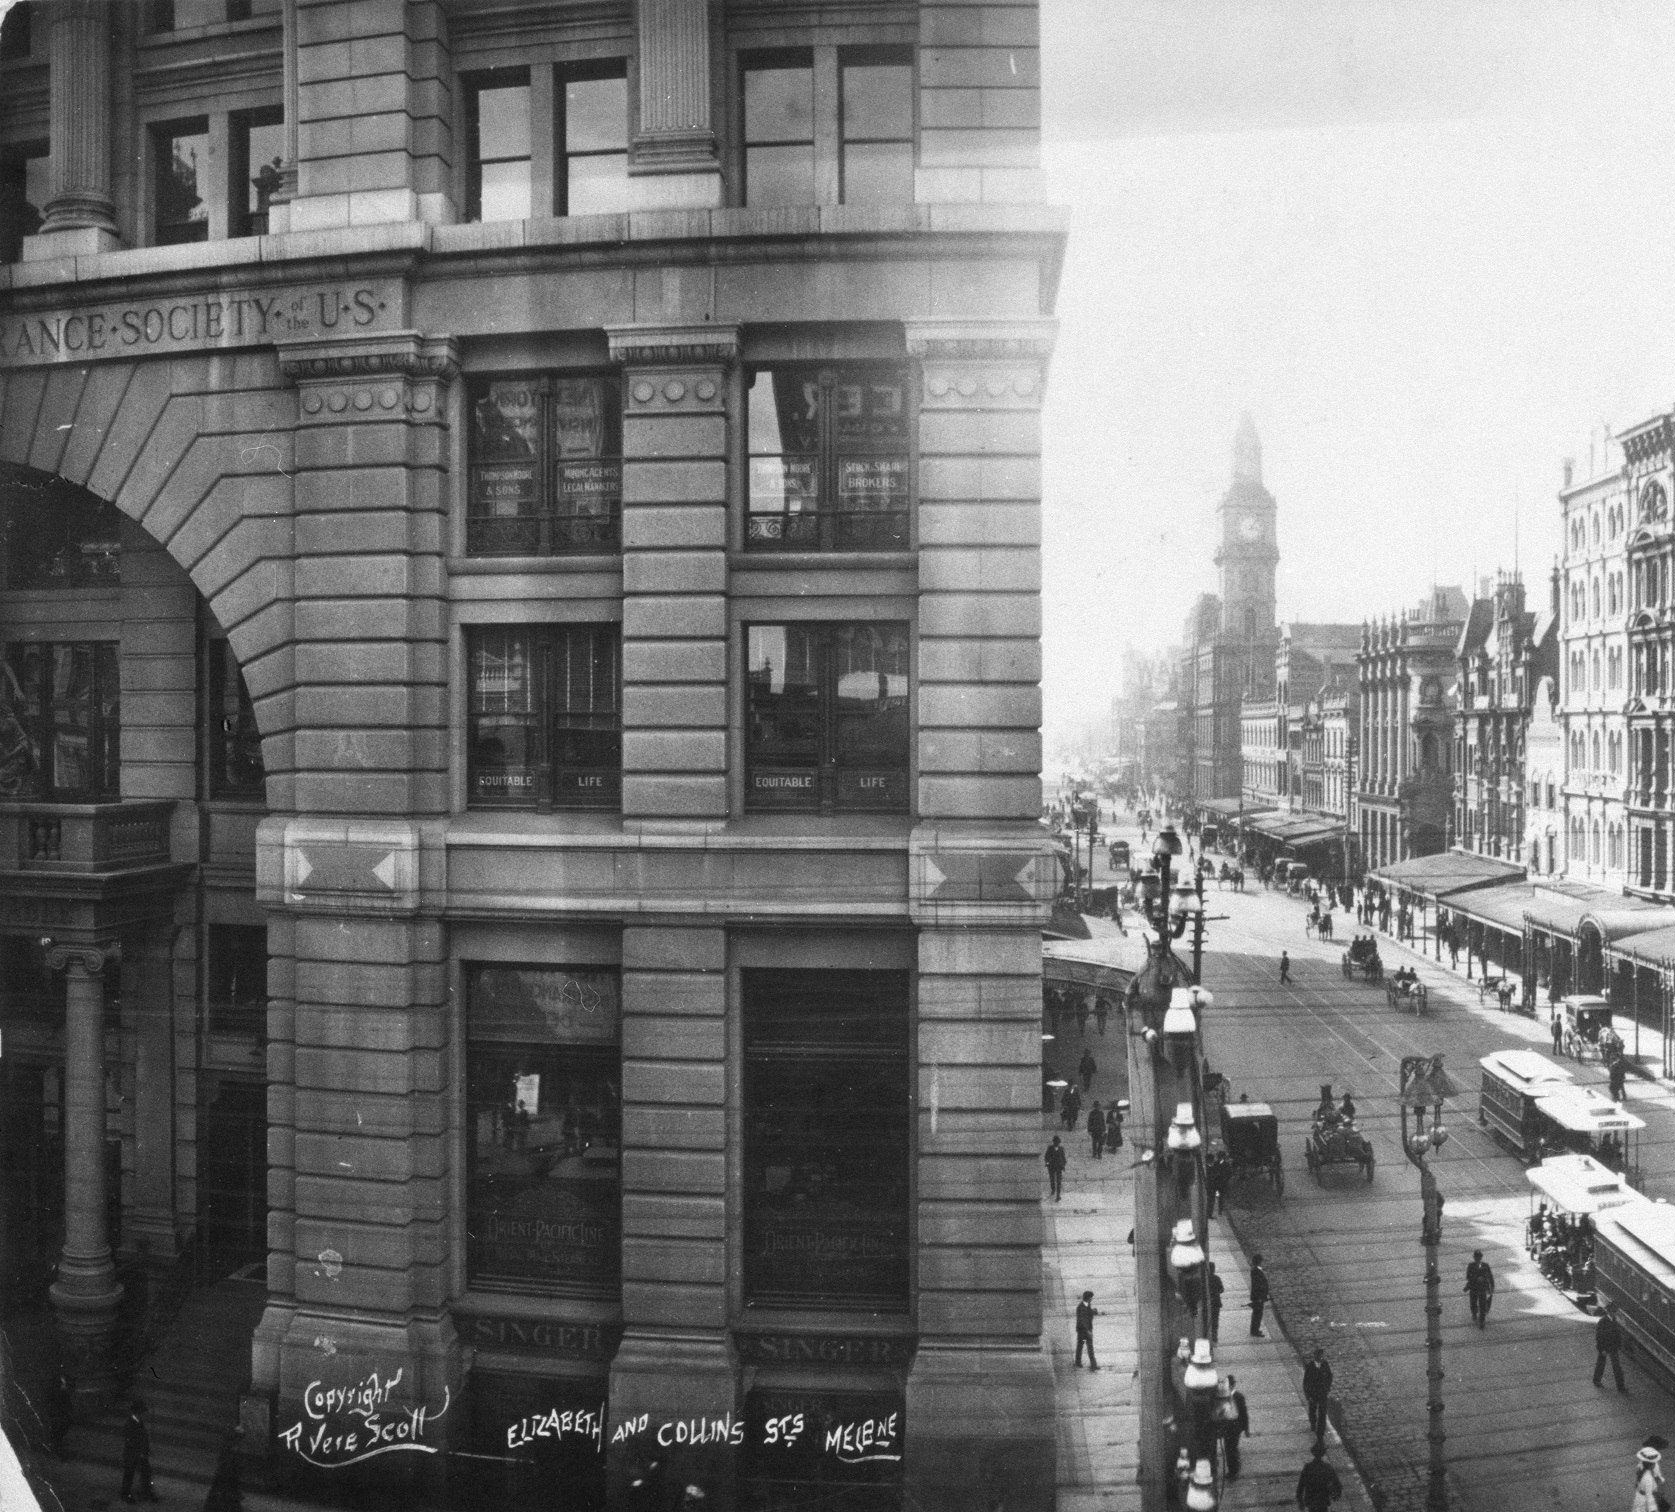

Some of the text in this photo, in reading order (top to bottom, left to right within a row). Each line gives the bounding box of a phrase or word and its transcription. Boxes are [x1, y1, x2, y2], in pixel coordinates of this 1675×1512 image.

[291, 299, 304, 312] of
[120, 297, 278, 345] SOCIETY
[286, 315, 310, 331] the
[848, 477, 897, 488] BROKERS
[486, 485, 521, 496] & SONS
[479, 774, 533, 788] EQUITABLE
[578, 775, 603, 788] LIFE
[755, 776, 813, 789] EQUITABLE
[859, 776, 886, 789] LIFE
[475, 1318, 602, 1351] SINGER
[760, 1336, 890, 1363] SINGER
